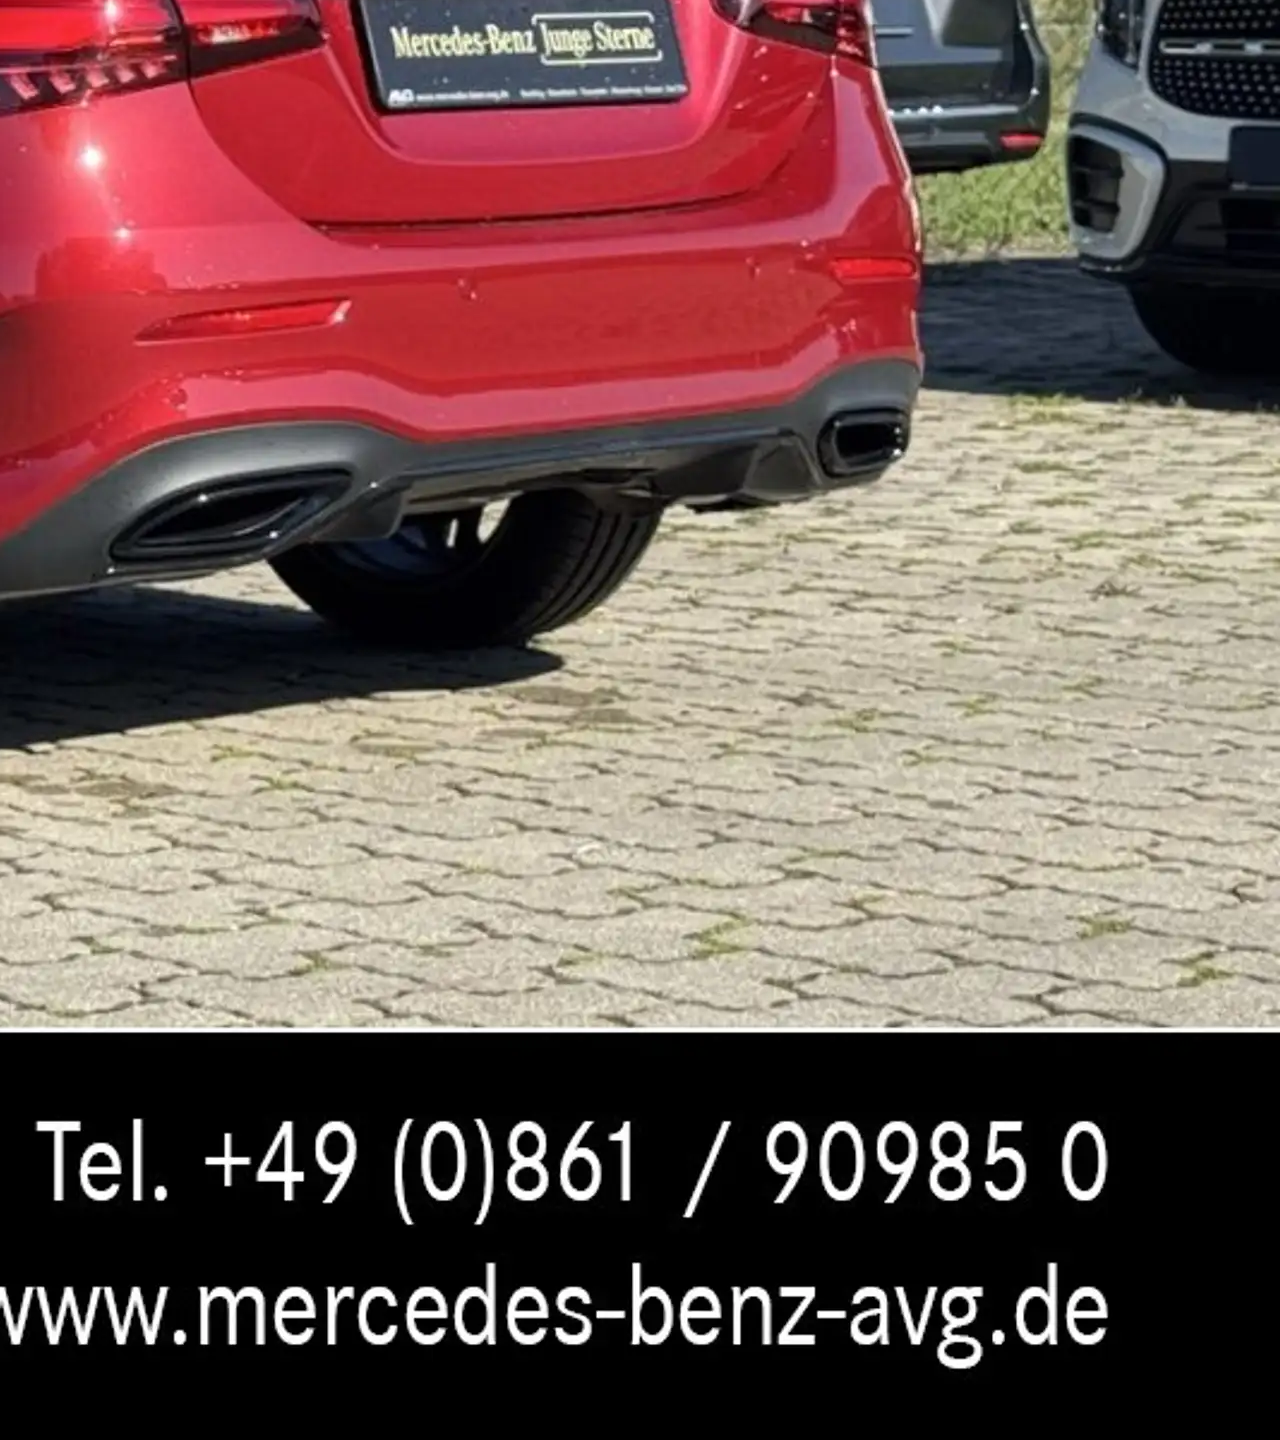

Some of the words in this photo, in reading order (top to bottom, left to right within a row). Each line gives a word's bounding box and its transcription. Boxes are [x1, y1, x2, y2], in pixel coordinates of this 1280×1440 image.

[390, 22, 537, 59] Mercedes-Benz
[541, 23, 595, 58] Junge
[594, 20, 656, 51] Sterne
